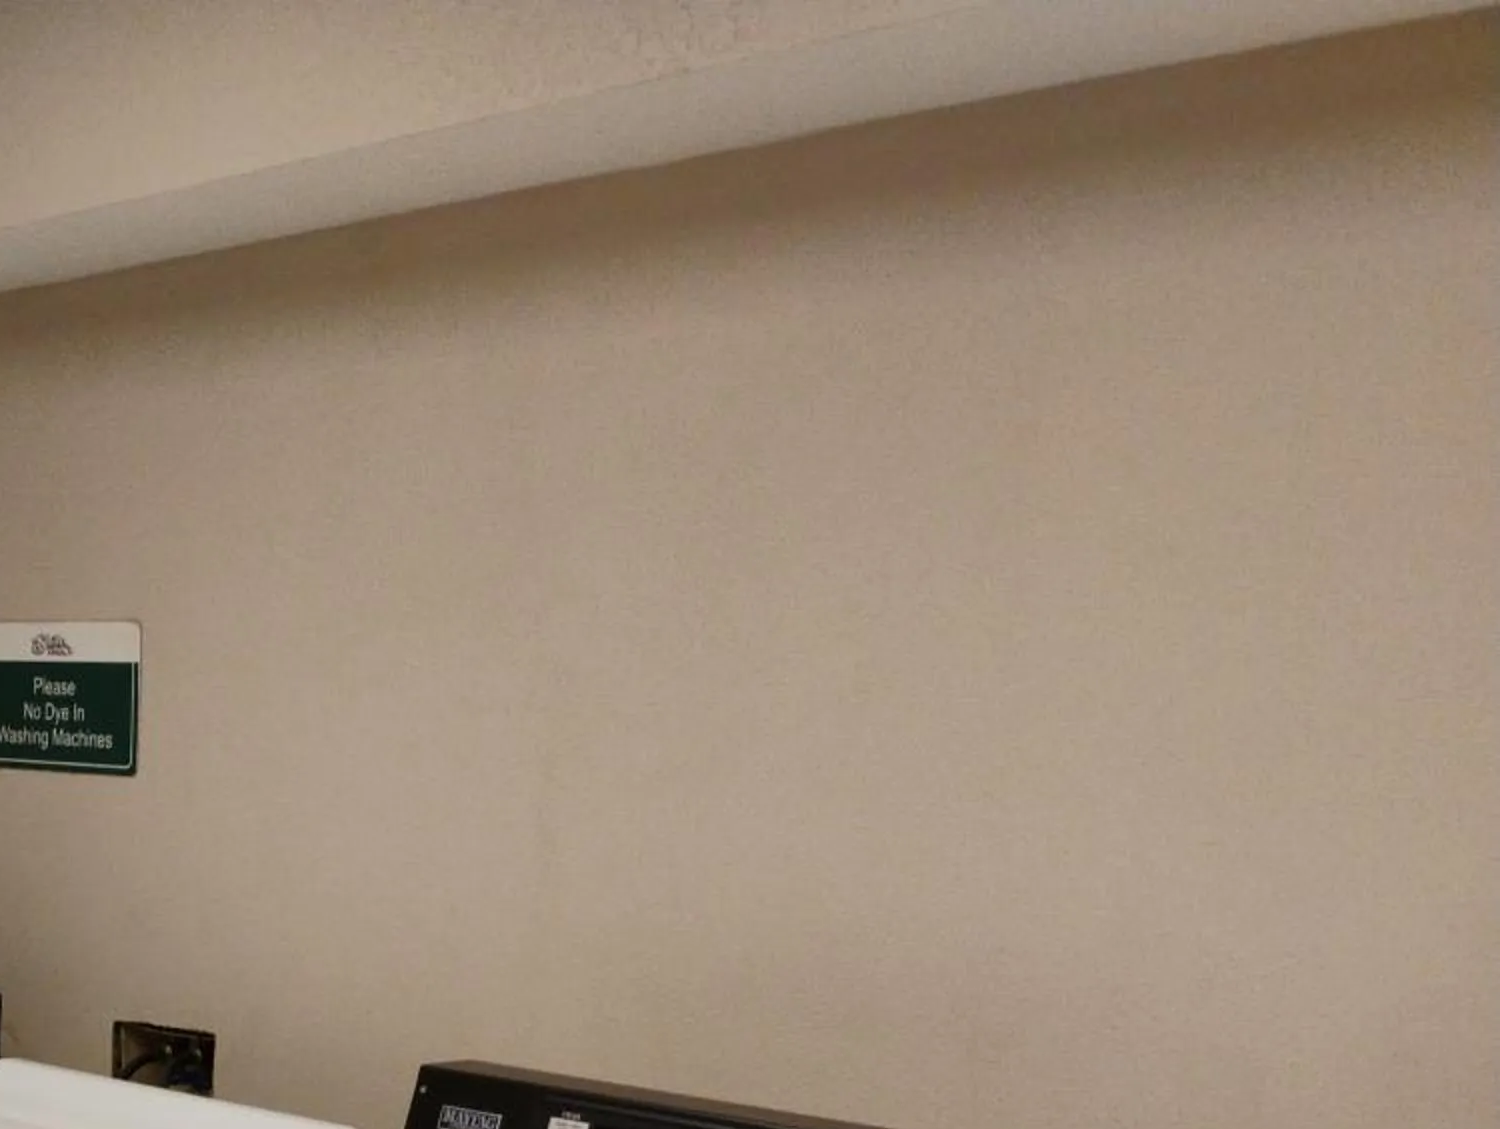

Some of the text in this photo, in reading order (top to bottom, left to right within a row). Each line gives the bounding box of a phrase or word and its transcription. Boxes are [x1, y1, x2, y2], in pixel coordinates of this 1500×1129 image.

[33, 676, 77, 696] Please
[23, 702, 85, 726] No Dye In
[51, 727, 113, 750] Machines
